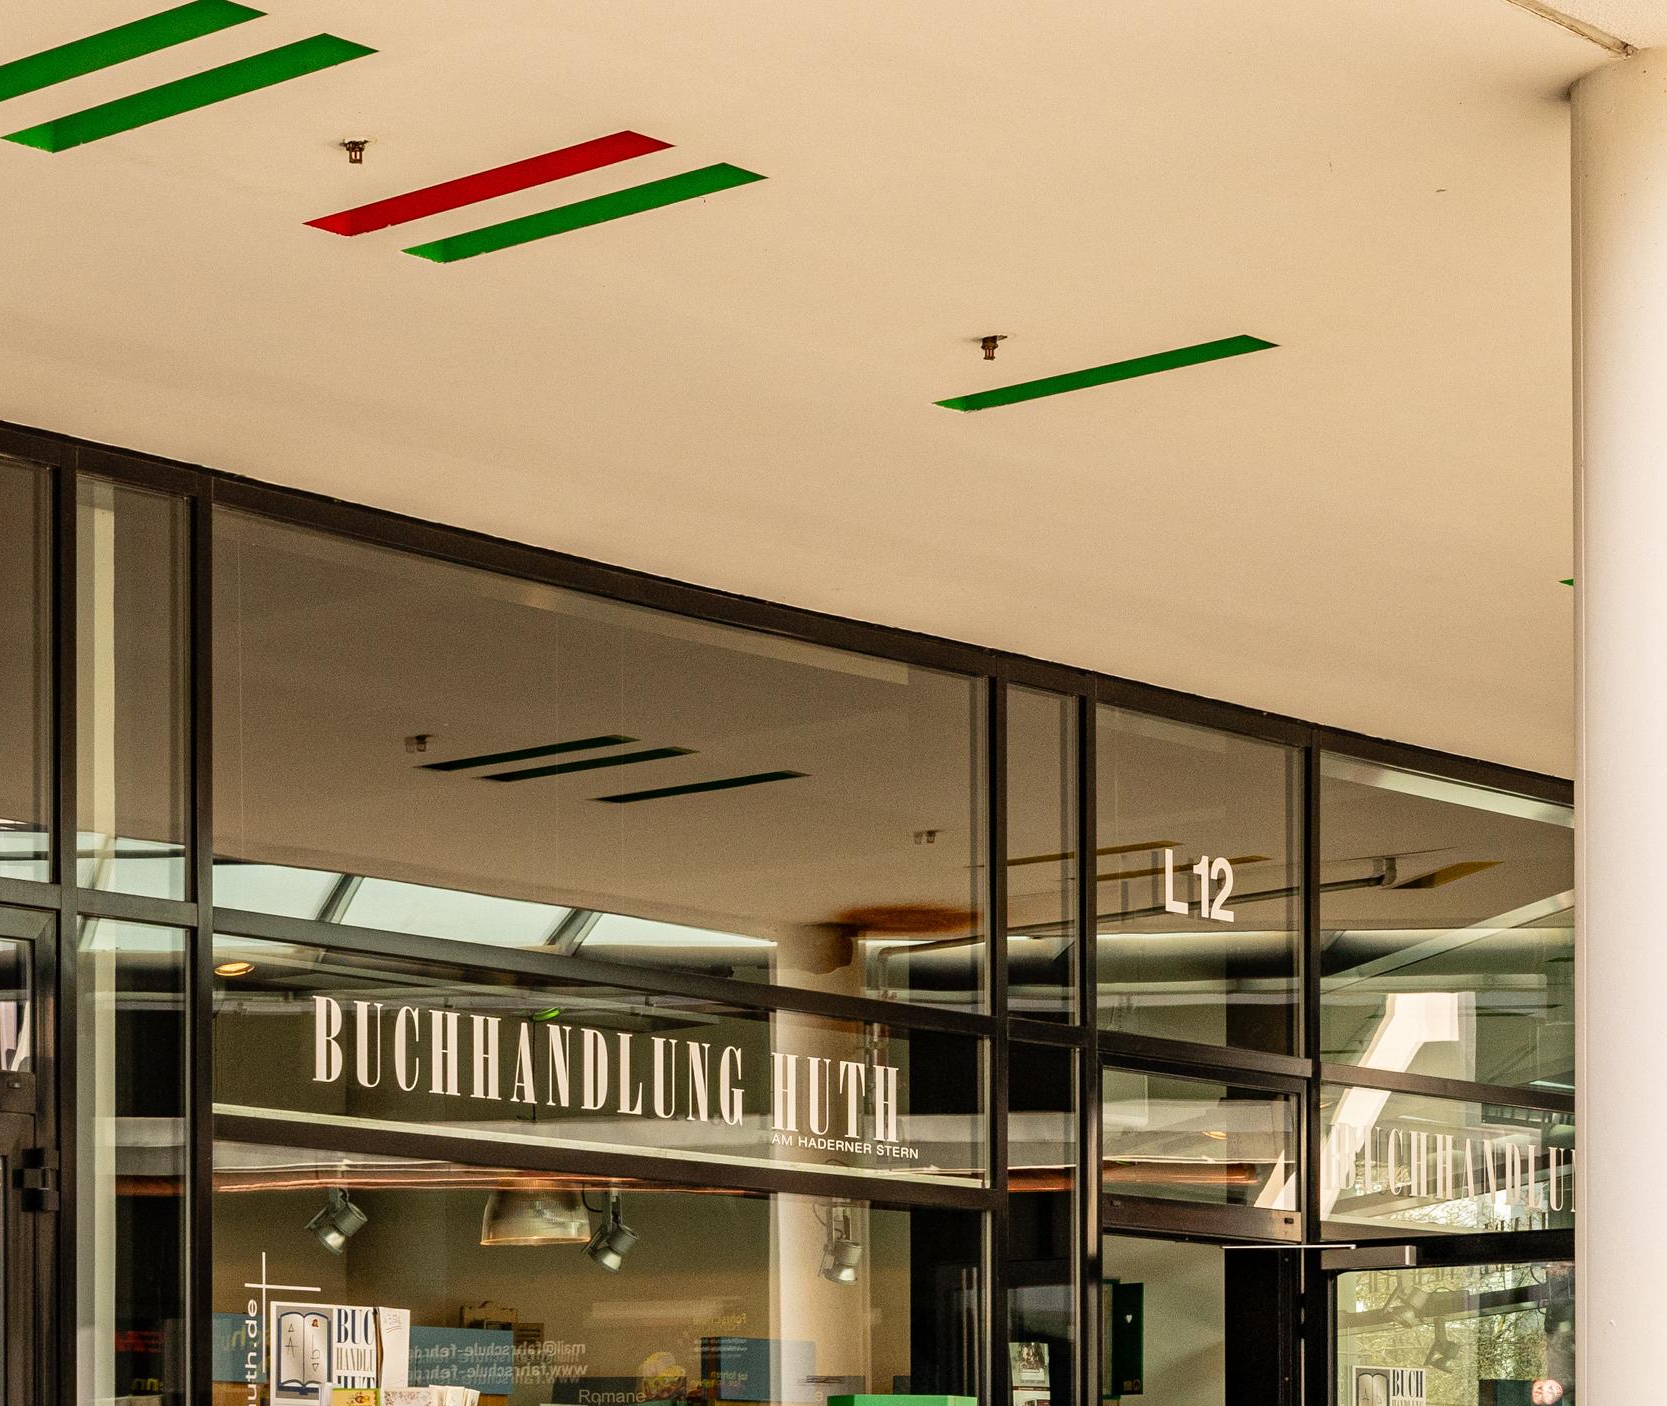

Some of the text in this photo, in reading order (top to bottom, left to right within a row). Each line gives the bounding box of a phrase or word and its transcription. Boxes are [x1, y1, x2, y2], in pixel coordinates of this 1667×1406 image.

[312, 995, 900, 1143] BUCHHANDLUNG HUTH
[772, 1135, 919, 1159] AM HADERNER STERN
[336, 1308, 375, 1345] BUC
[578, 1388, 647, 1403] Romane
[1392, 1370, 1424, 1398] BUCH
